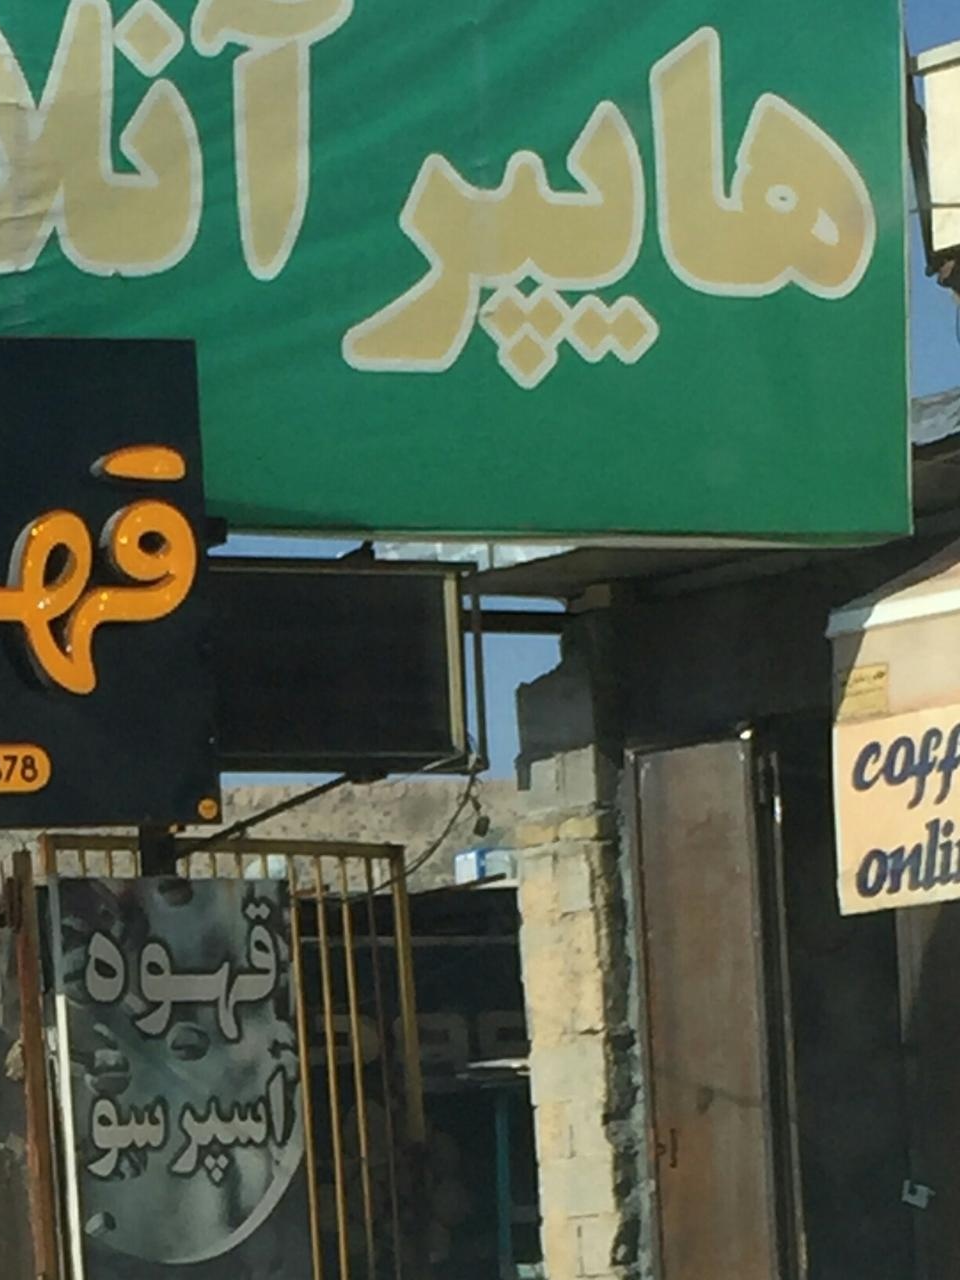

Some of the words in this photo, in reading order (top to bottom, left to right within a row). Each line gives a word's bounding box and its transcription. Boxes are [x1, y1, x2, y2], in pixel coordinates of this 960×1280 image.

[342, 26, 877, 390] هایپر
[856, 818, 960, 897] onli
[85, 902, 276, 1039] قهوه
